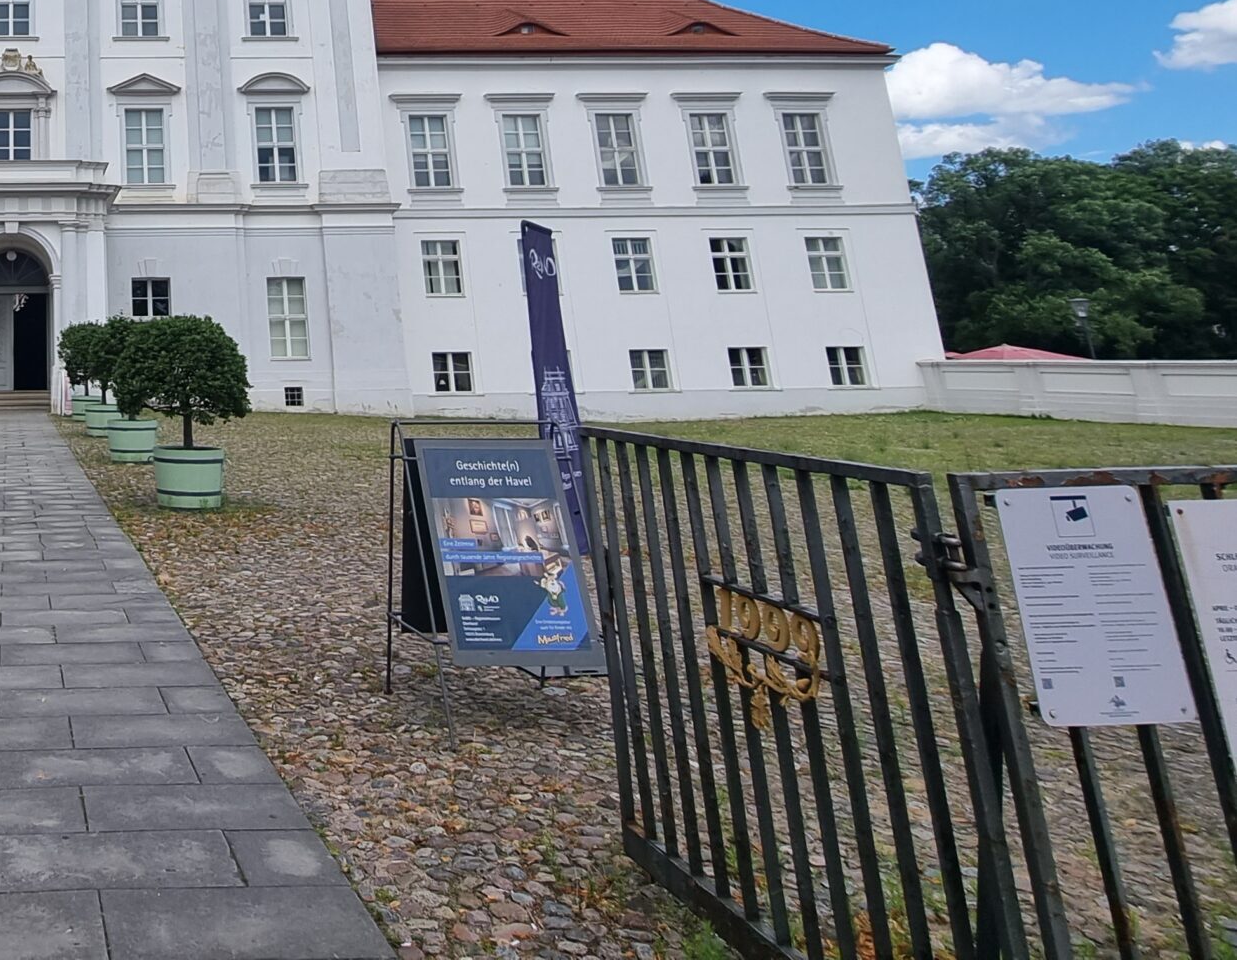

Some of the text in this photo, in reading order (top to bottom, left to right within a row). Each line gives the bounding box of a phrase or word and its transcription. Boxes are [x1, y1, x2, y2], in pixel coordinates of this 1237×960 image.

[456, 460, 520, 473] Geschichte(n)
[450, 476, 532, 489] entlang der Havel
[1046, 542, 1114, 551] VIDEOÜBERWACHUNG
[1049, 551, 1115, 560] VIDEO SURVEILLANCE
